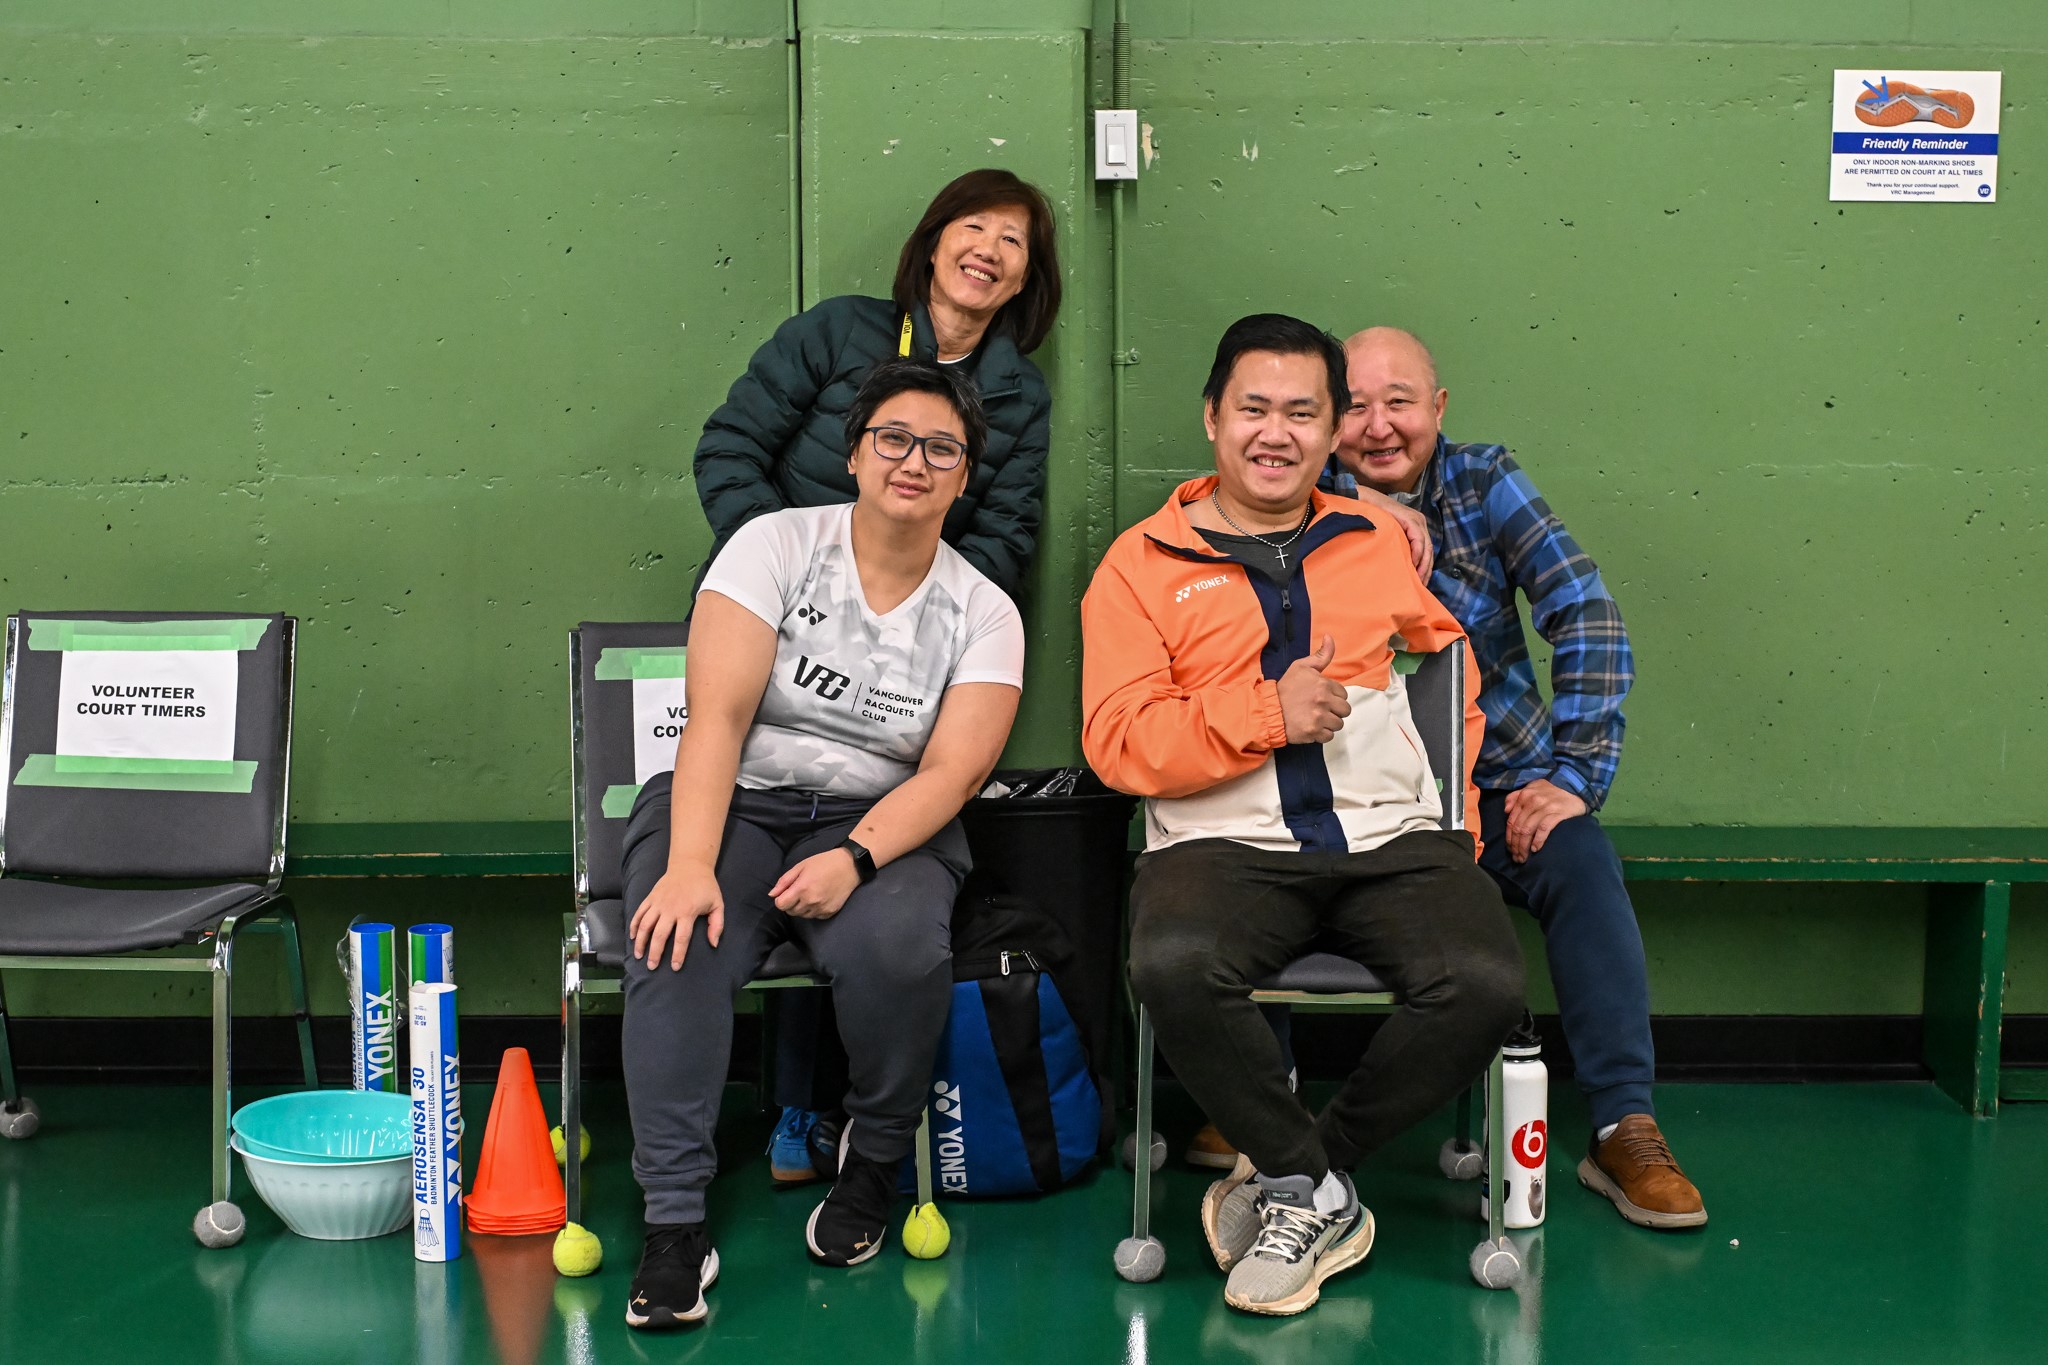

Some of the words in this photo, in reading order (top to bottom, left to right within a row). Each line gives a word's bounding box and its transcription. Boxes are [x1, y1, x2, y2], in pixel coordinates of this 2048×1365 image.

[1862, 138, 1909, 151] Friendly
[1912, 139, 1968, 150] Reminder
[1193, 574, 1230, 592] YONEX
[92, 685, 195, 699] VOLUNTEER
[869, 686, 924, 706] VANCOUVER
[77, 702, 137, 716] COURT
[141, 703, 206, 718] TIMERS
[861, 709, 887, 723] CLUB
[864, 698, 915, 718] RACQUETS
[365, 989, 394, 1082] YONEX
[412, 1067, 425, 1089] 30
[428, 1084, 436, 1131] SHUTTLECOCK
[413, 1100, 428, 1205] AEROSENSA
[429, 1132, 437, 1163] FEATHER
[938, 1126, 968, 1194] YONEX
[429, 1165, 438, 1205] BADMINTON
